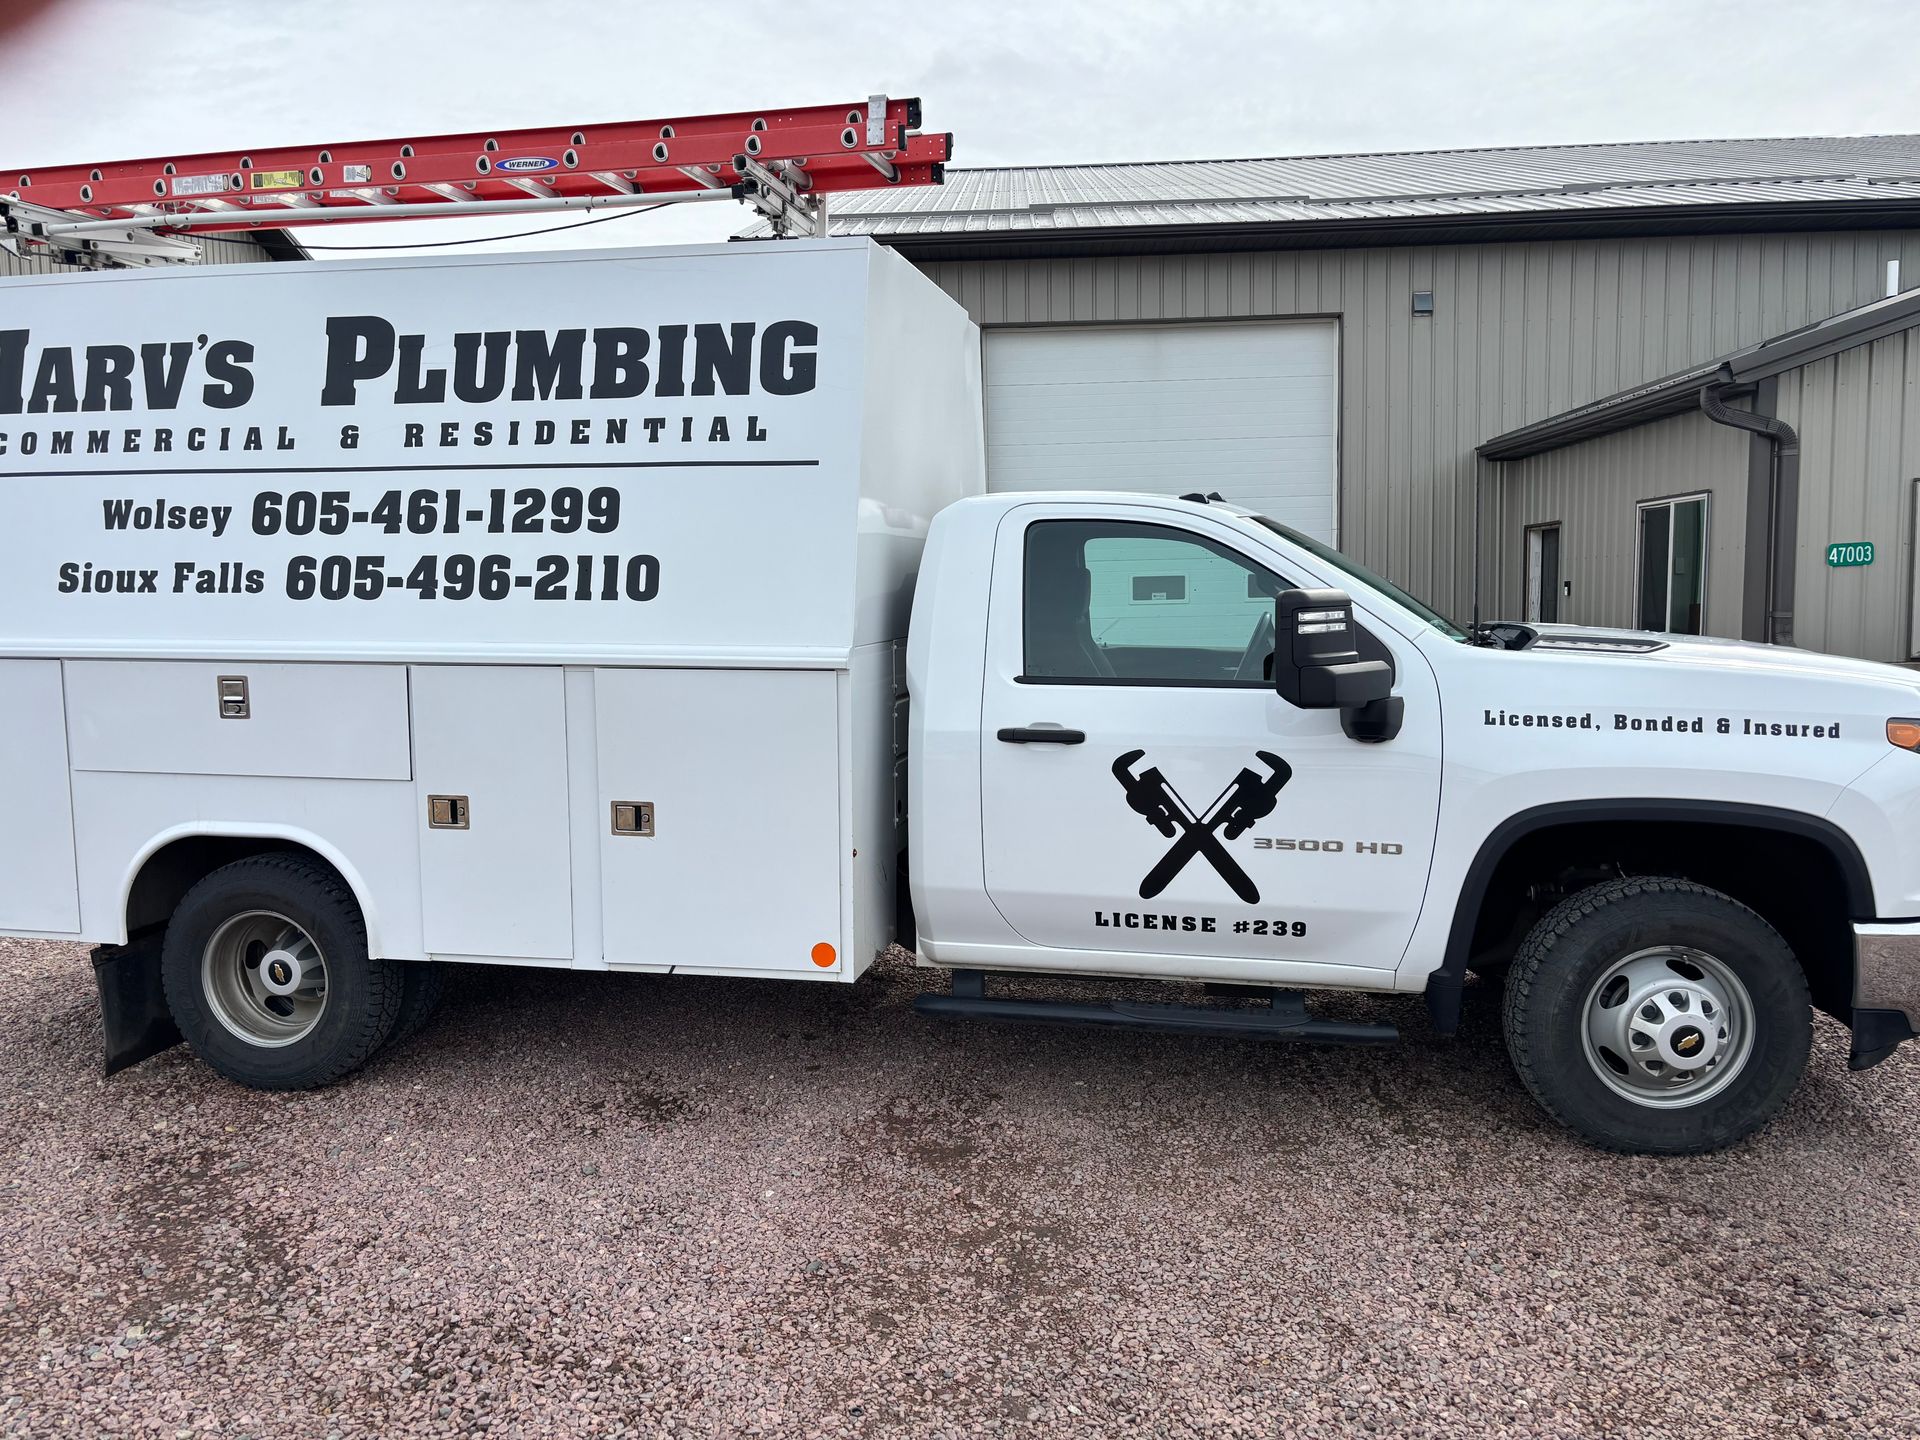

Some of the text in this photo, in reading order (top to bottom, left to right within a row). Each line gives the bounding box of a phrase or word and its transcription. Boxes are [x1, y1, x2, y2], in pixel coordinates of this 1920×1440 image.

[508, 160, 546, 169] WERNER
[320, 315, 819, 407] PLUMBING
[340, 424, 360, 449] &
[403, 415, 767, 448] RESIDENTIAL
[102, 486, 621, 538] Wolsey 605-461-1299
[1829, 545, 1872, 563] 47003
[58, 553, 660, 602] Sioux Falls 605-496-2110
[1484, 709, 1841, 739] Licensed, Bonded & Insured
[1253, 837, 1404, 855] 3500 HD
[1094, 911, 1308, 938] LICENSE #239
